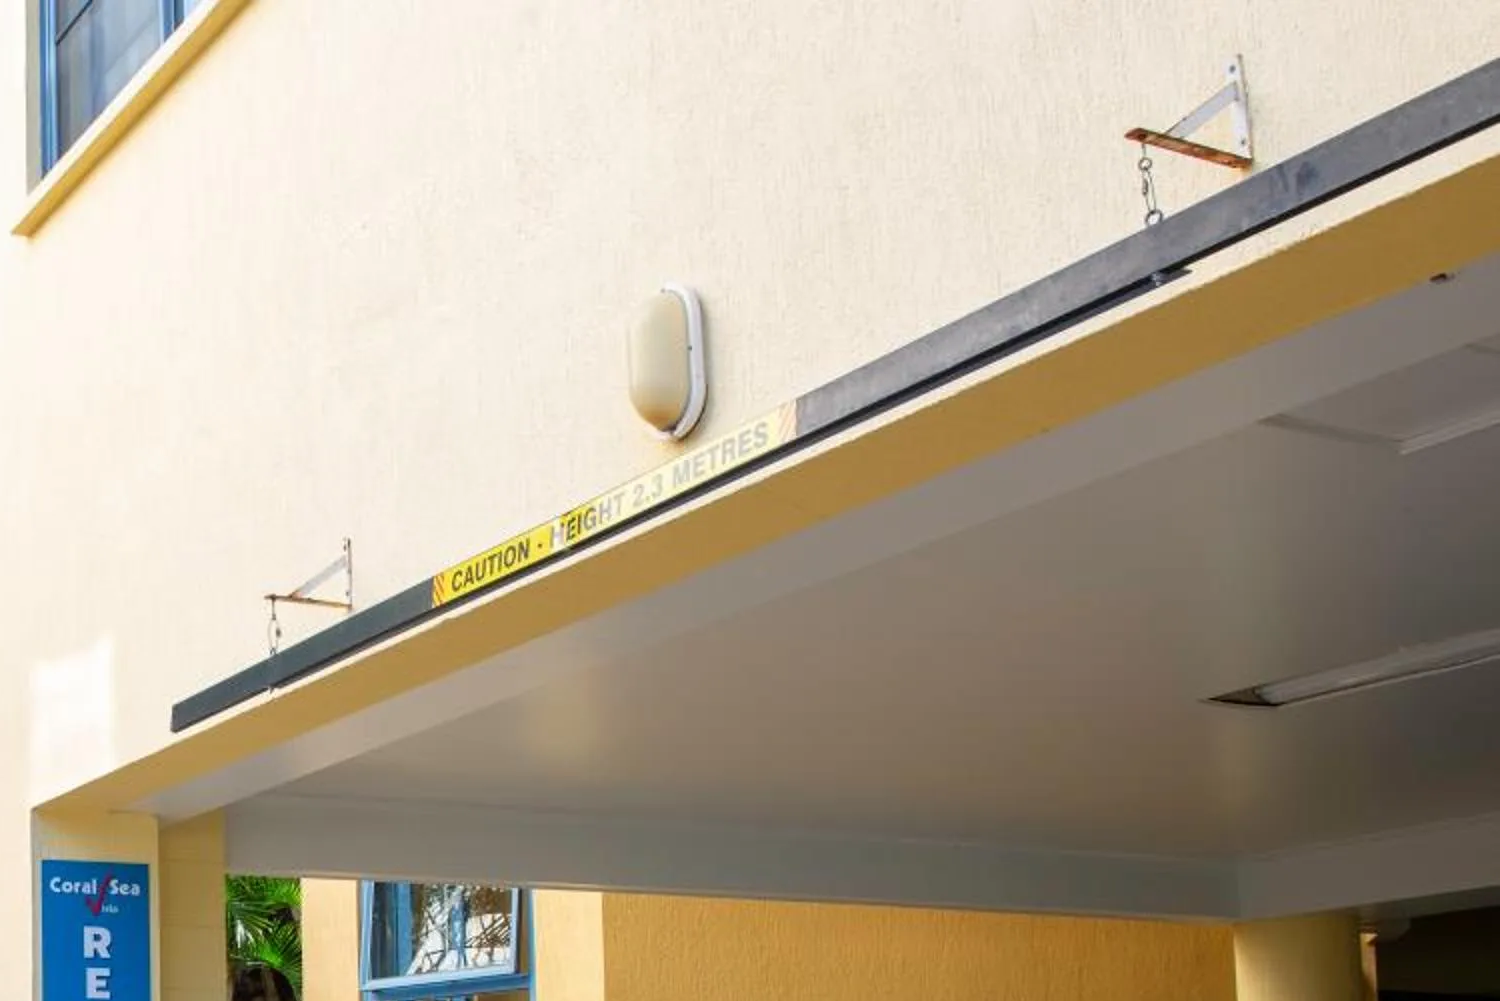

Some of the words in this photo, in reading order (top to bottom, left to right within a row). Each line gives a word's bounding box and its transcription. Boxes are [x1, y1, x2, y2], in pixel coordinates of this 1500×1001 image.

[451, 537, 531, 593] CAUTION
[550, 491, 627, 549] HEIGHT
[632, 475, 664, 507] 2.3
[671, 422, 770, 488] METRES
[49, 876, 98, 895] Coral
[108, 878, 141, 896] Sea
